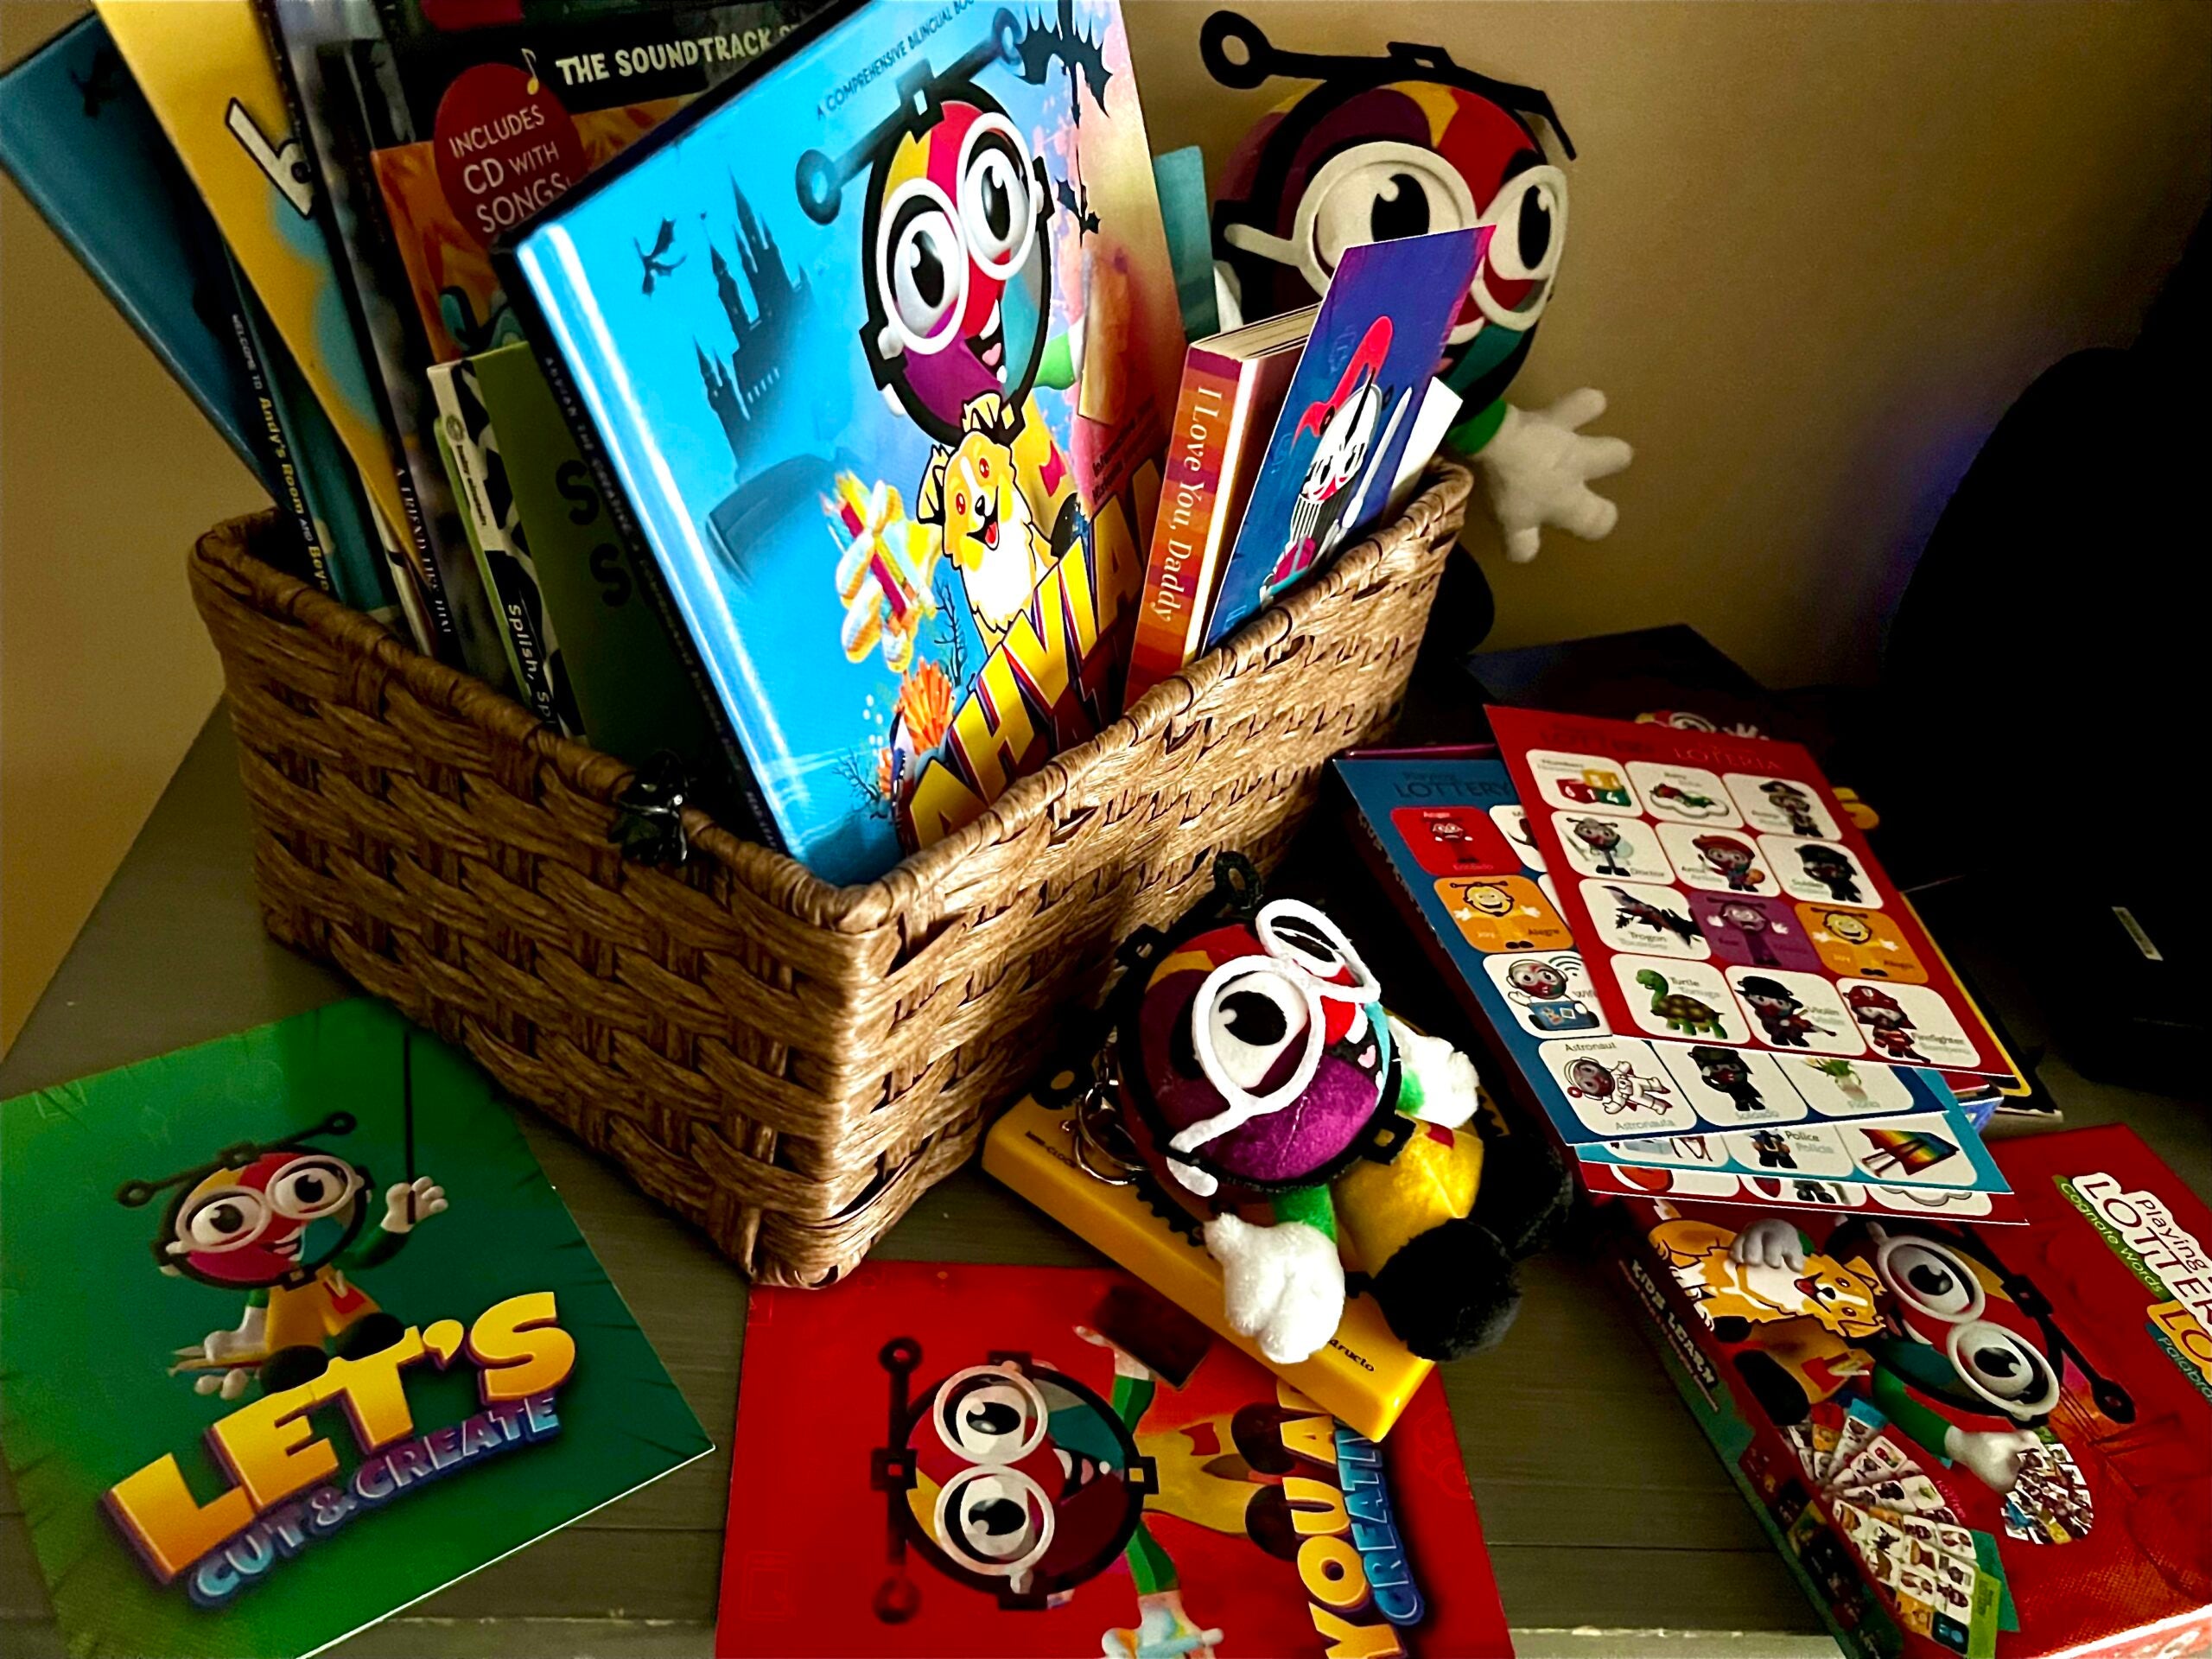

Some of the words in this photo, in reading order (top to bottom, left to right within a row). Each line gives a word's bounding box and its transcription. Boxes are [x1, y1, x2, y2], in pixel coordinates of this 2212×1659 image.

[555, 53, 608, 86] THE
[618, 27, 772, 76] SOUNDTRACK
[817, 105, 826, 121] A
[826, 41, 906, 111] COMPREHENSIVE
[907, 7, 952, 49] BILINGUAL
[448, 104, 546, 159] INCLUDES
[463, 157, 505, 194] CD
[507, 140, 560, 175] WITH
[231, 313, 257, 372] WELCOME
[251, 373, 264, 390] TO
[258, 395, 287, 460] Andy's
[281, 462, 305, 516] Room
[1197, 386, 1223, 399] I
[1183, 405, 1221, 472] Love
[1168, 480, 1205, 531] You,
[1149, 538, 1193, 623] Daddy
[507, 602, 539, 681] Splish,
[1392, 780, 1511, 798] LOTTERY
[1669, 976, 1700, 988] Turtle
[1565, 1042, 1617, 1052] Astronaut
[1784, 1130, 1821, 1142] Police
[2060, 1182, 2120, 1244] Cognate
[2134, 1198, 2209, 1272] Playing
[1631, 1257, 1667, 1311] KIDS
[1668, 1311, 1716, 1384] LEARN
[2158, 1336, 2212, 1404] Palabra
[108, 1289, 578, 1576] LET'S
[195, 1514, 307, 1599] CUT
[308, 1483, 358, 1528] &
[353, 1395, 561, 1502] CREATE
[1281, 1475, 1402, 1659] YOU
